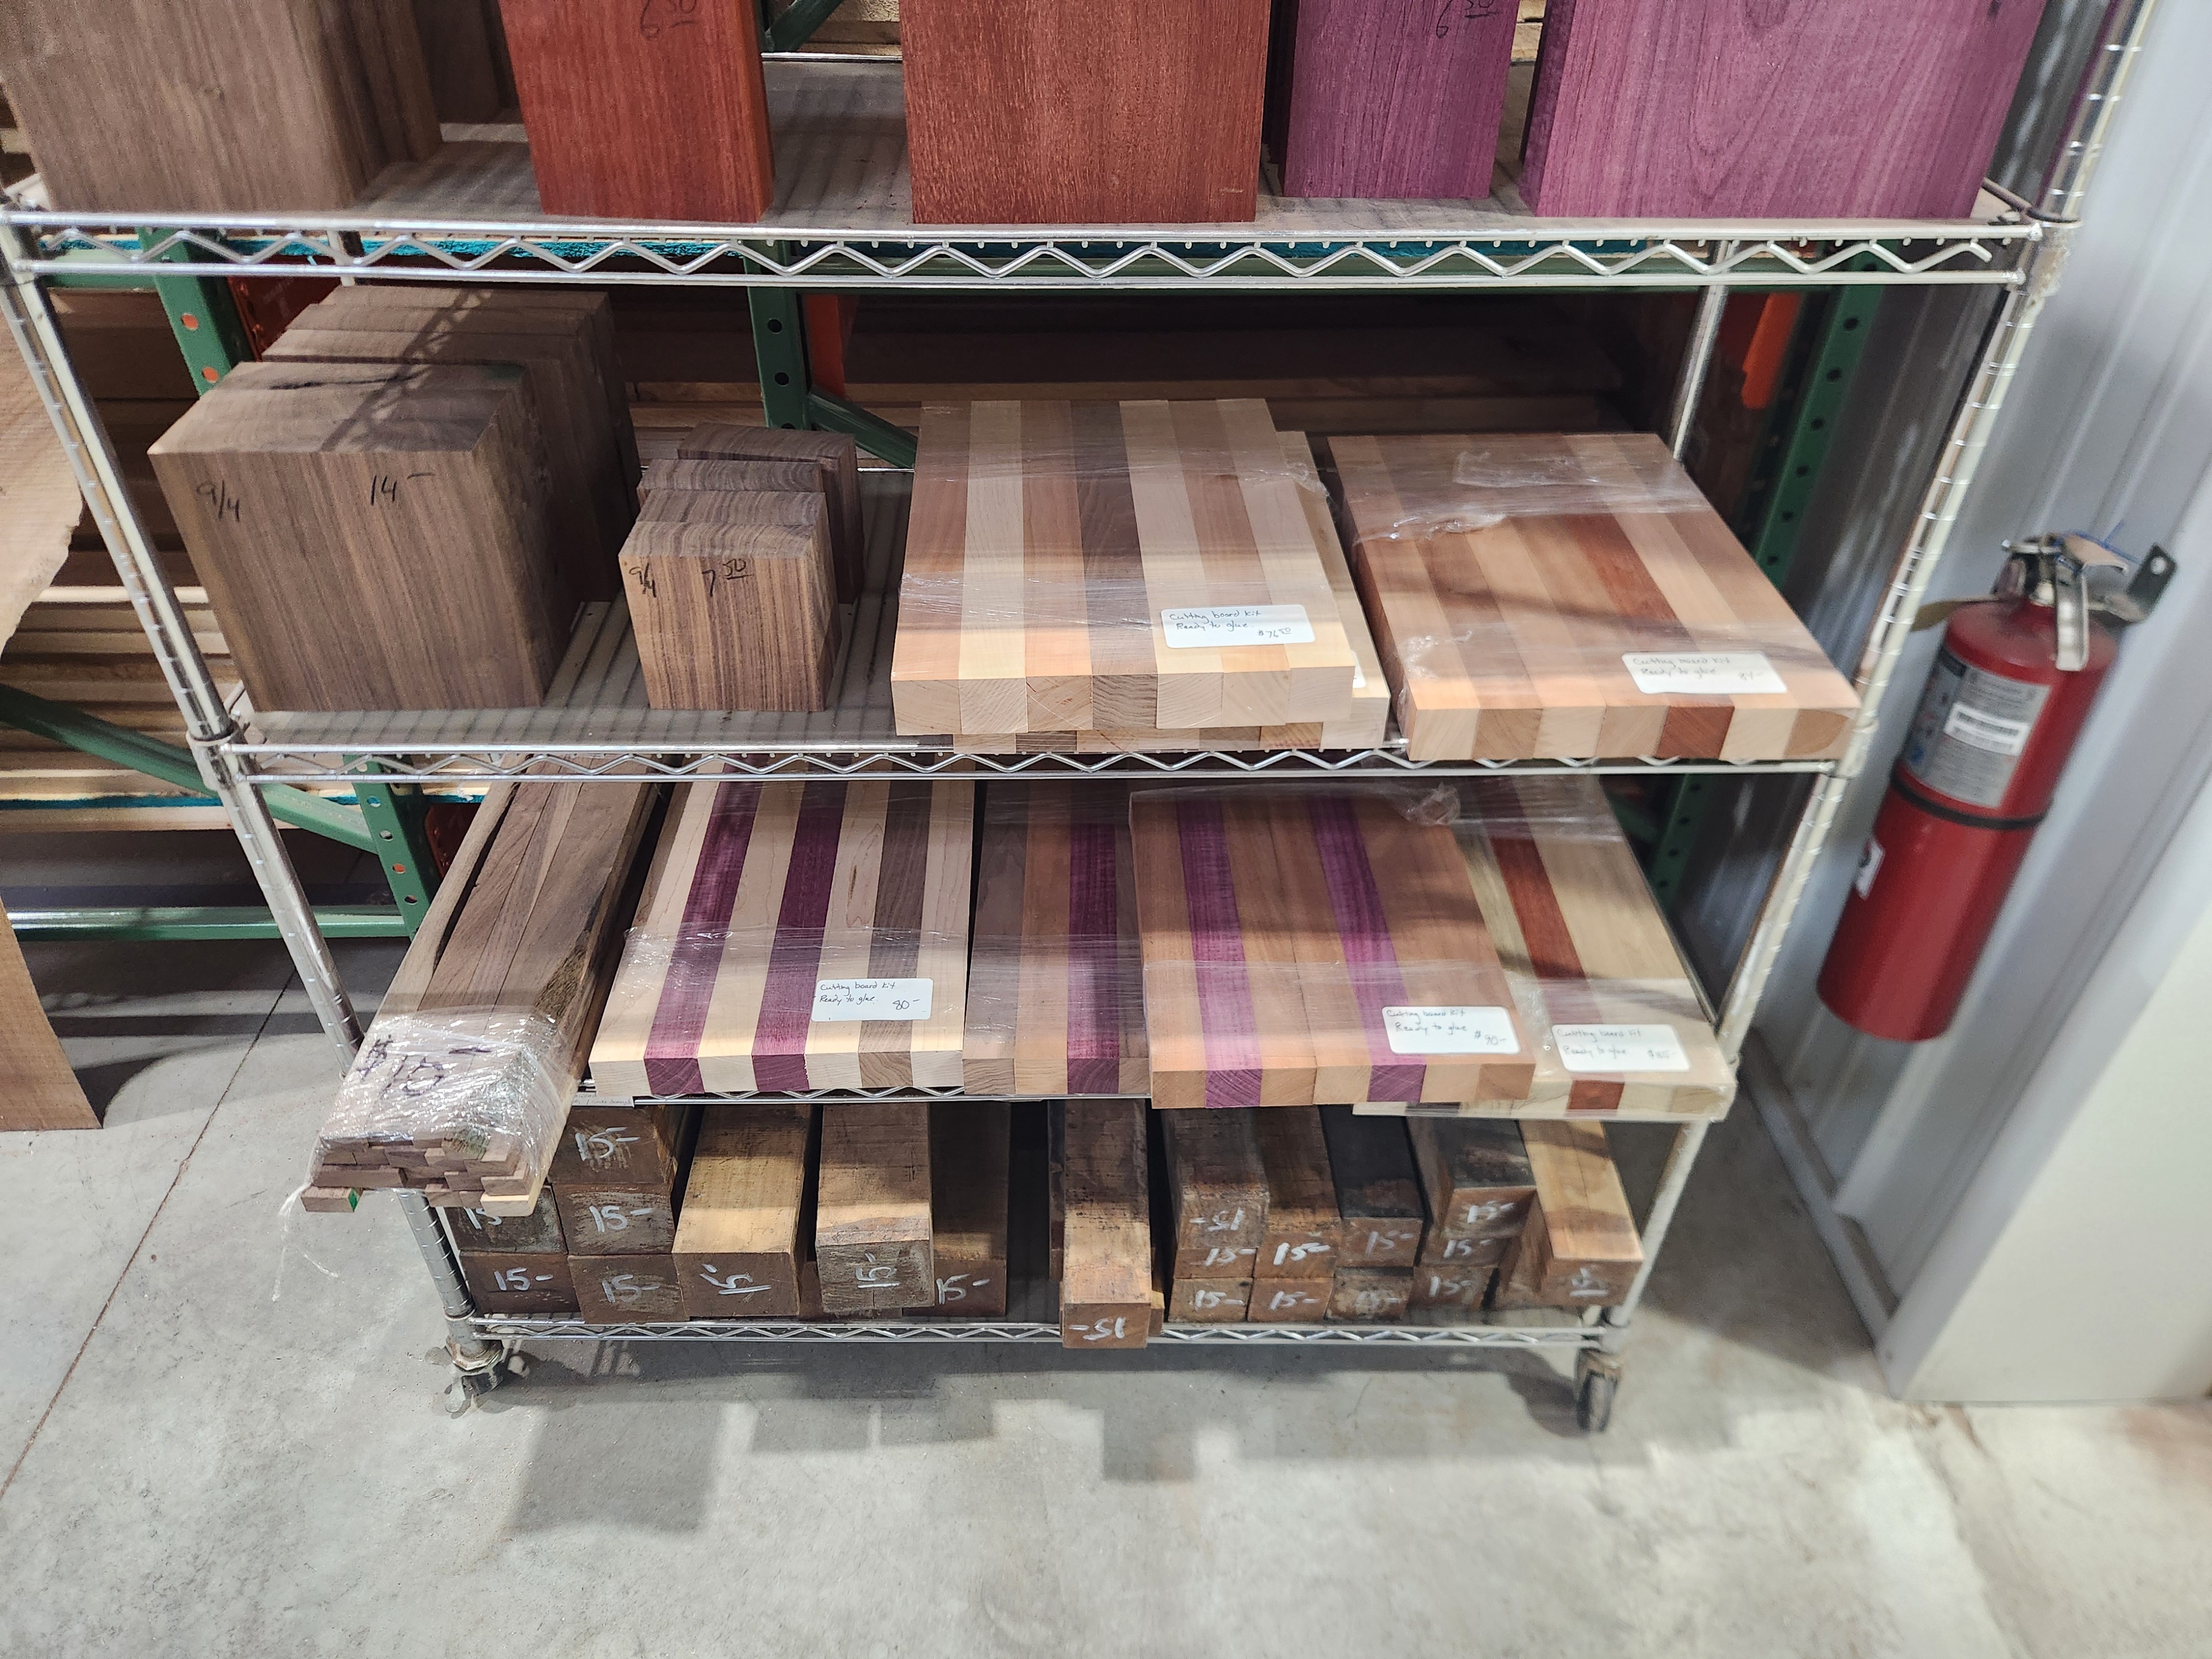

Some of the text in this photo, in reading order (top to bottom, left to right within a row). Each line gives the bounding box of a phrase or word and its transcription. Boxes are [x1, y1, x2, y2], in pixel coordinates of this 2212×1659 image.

[1211, 609, 1240, 618] board
[1176, 623, 1206, 632] Ready
[820, 995, 843, 1006] Ready
[846, 994, 854, 1002] to
[1395, 1021, 1468, 1036] Ready to glue
